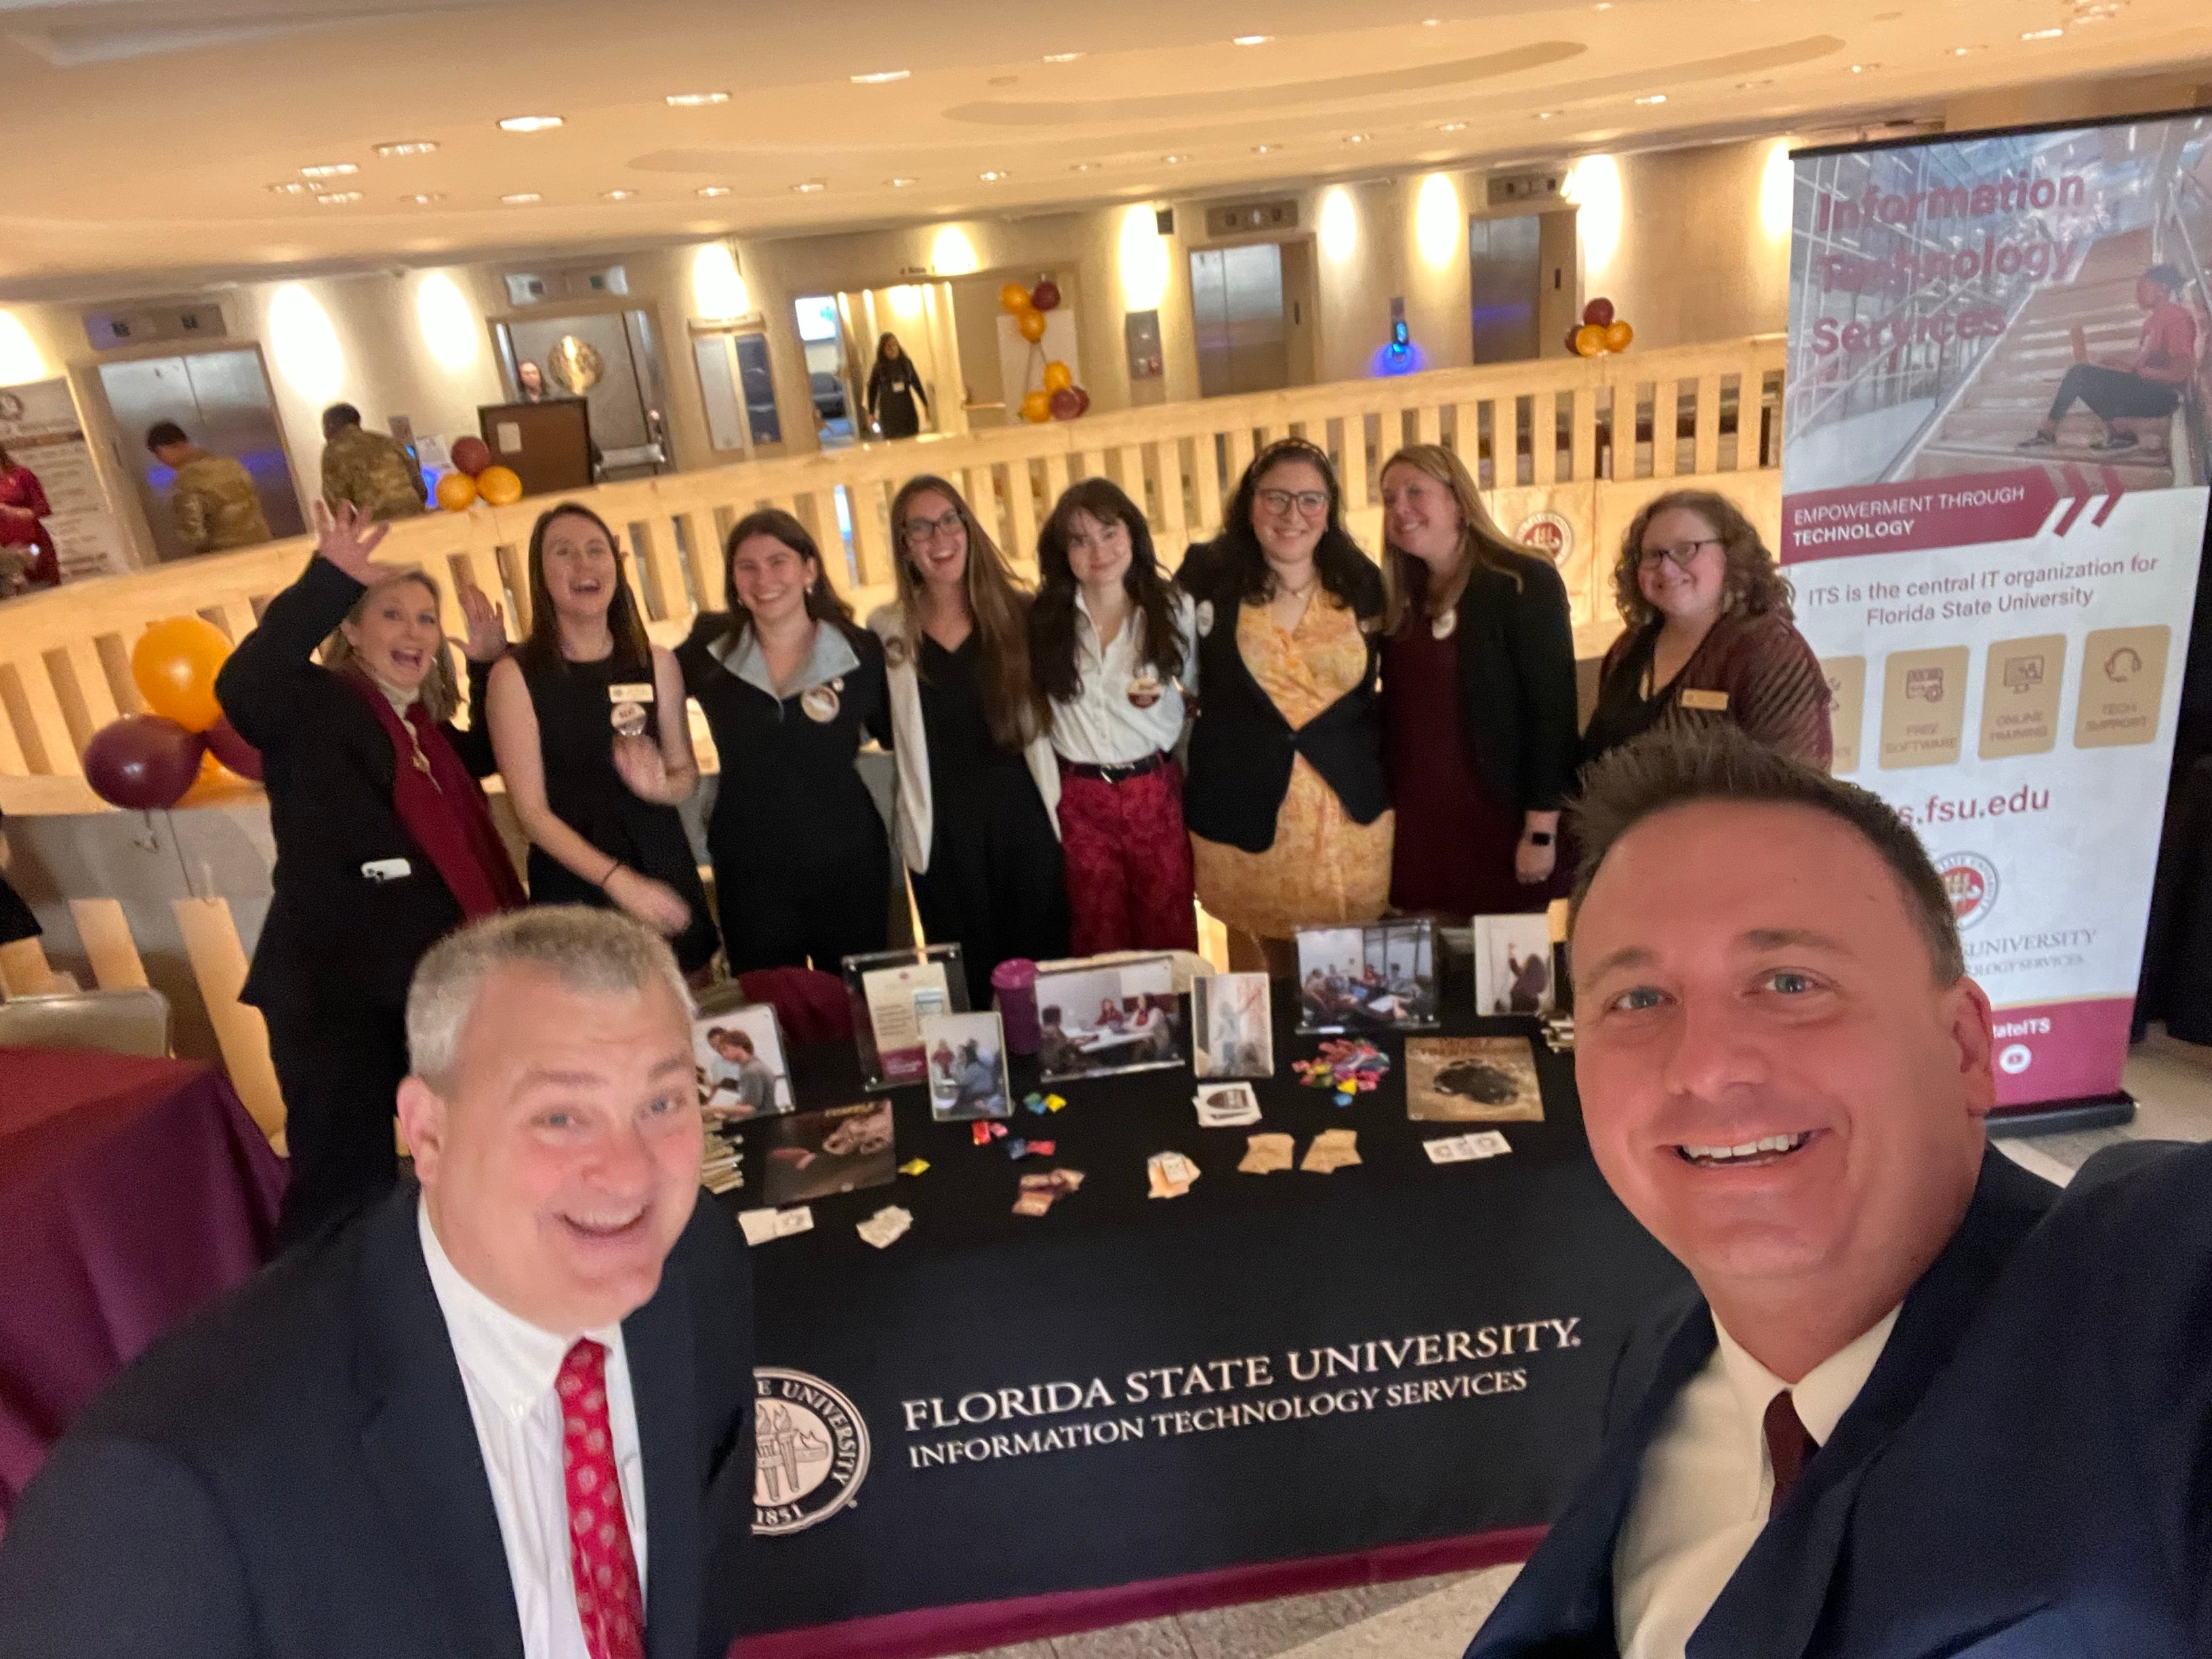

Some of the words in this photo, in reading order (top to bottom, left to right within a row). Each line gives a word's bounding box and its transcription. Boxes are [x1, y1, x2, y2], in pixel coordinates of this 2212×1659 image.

[1819, 169, 2085, 232] Information
[1811, 306, 2006, 355] Services
[1794, 495, 1933, 526] EMPOWERMENT
[1938, 485, 2024, 510] THROUGH
[1793, 519, 1914, 546] TECHNOLOGY
[1809, 586, 1839, 607] ITS
[1846, 583, 1862, 602] is
[1868, 581, 1900, 600] the
[1906, 573, 1975, 597] central
[1980, 569, 2000, 589] IT
[2004, 557, 2125, 588] organization
[2131, 552, 2159, 572] for
[1866, 605, 1936, 627] Florida
[1942, 598, 1992, 619] State
[1999, 586, 2094, 613] University
[1897, 783, 2049, 825] s.fsu.edu
[1967, 929, 2097, 957] UNIVERSITY
[902, 1377, 1115, 1431] FLORIDA
[1126, 1355, 1274, 1404] STATE
[781, 1380, 857, 1487] UNIVERSITY
[909, 1417, 1144, 1469] INFORMATION
[1151, 1387, 1380, 1437] TECHNOLOGY
[1386, 1368, 1527, 1408] SERVICES
[756, 1502, 804, 1525] 1851
